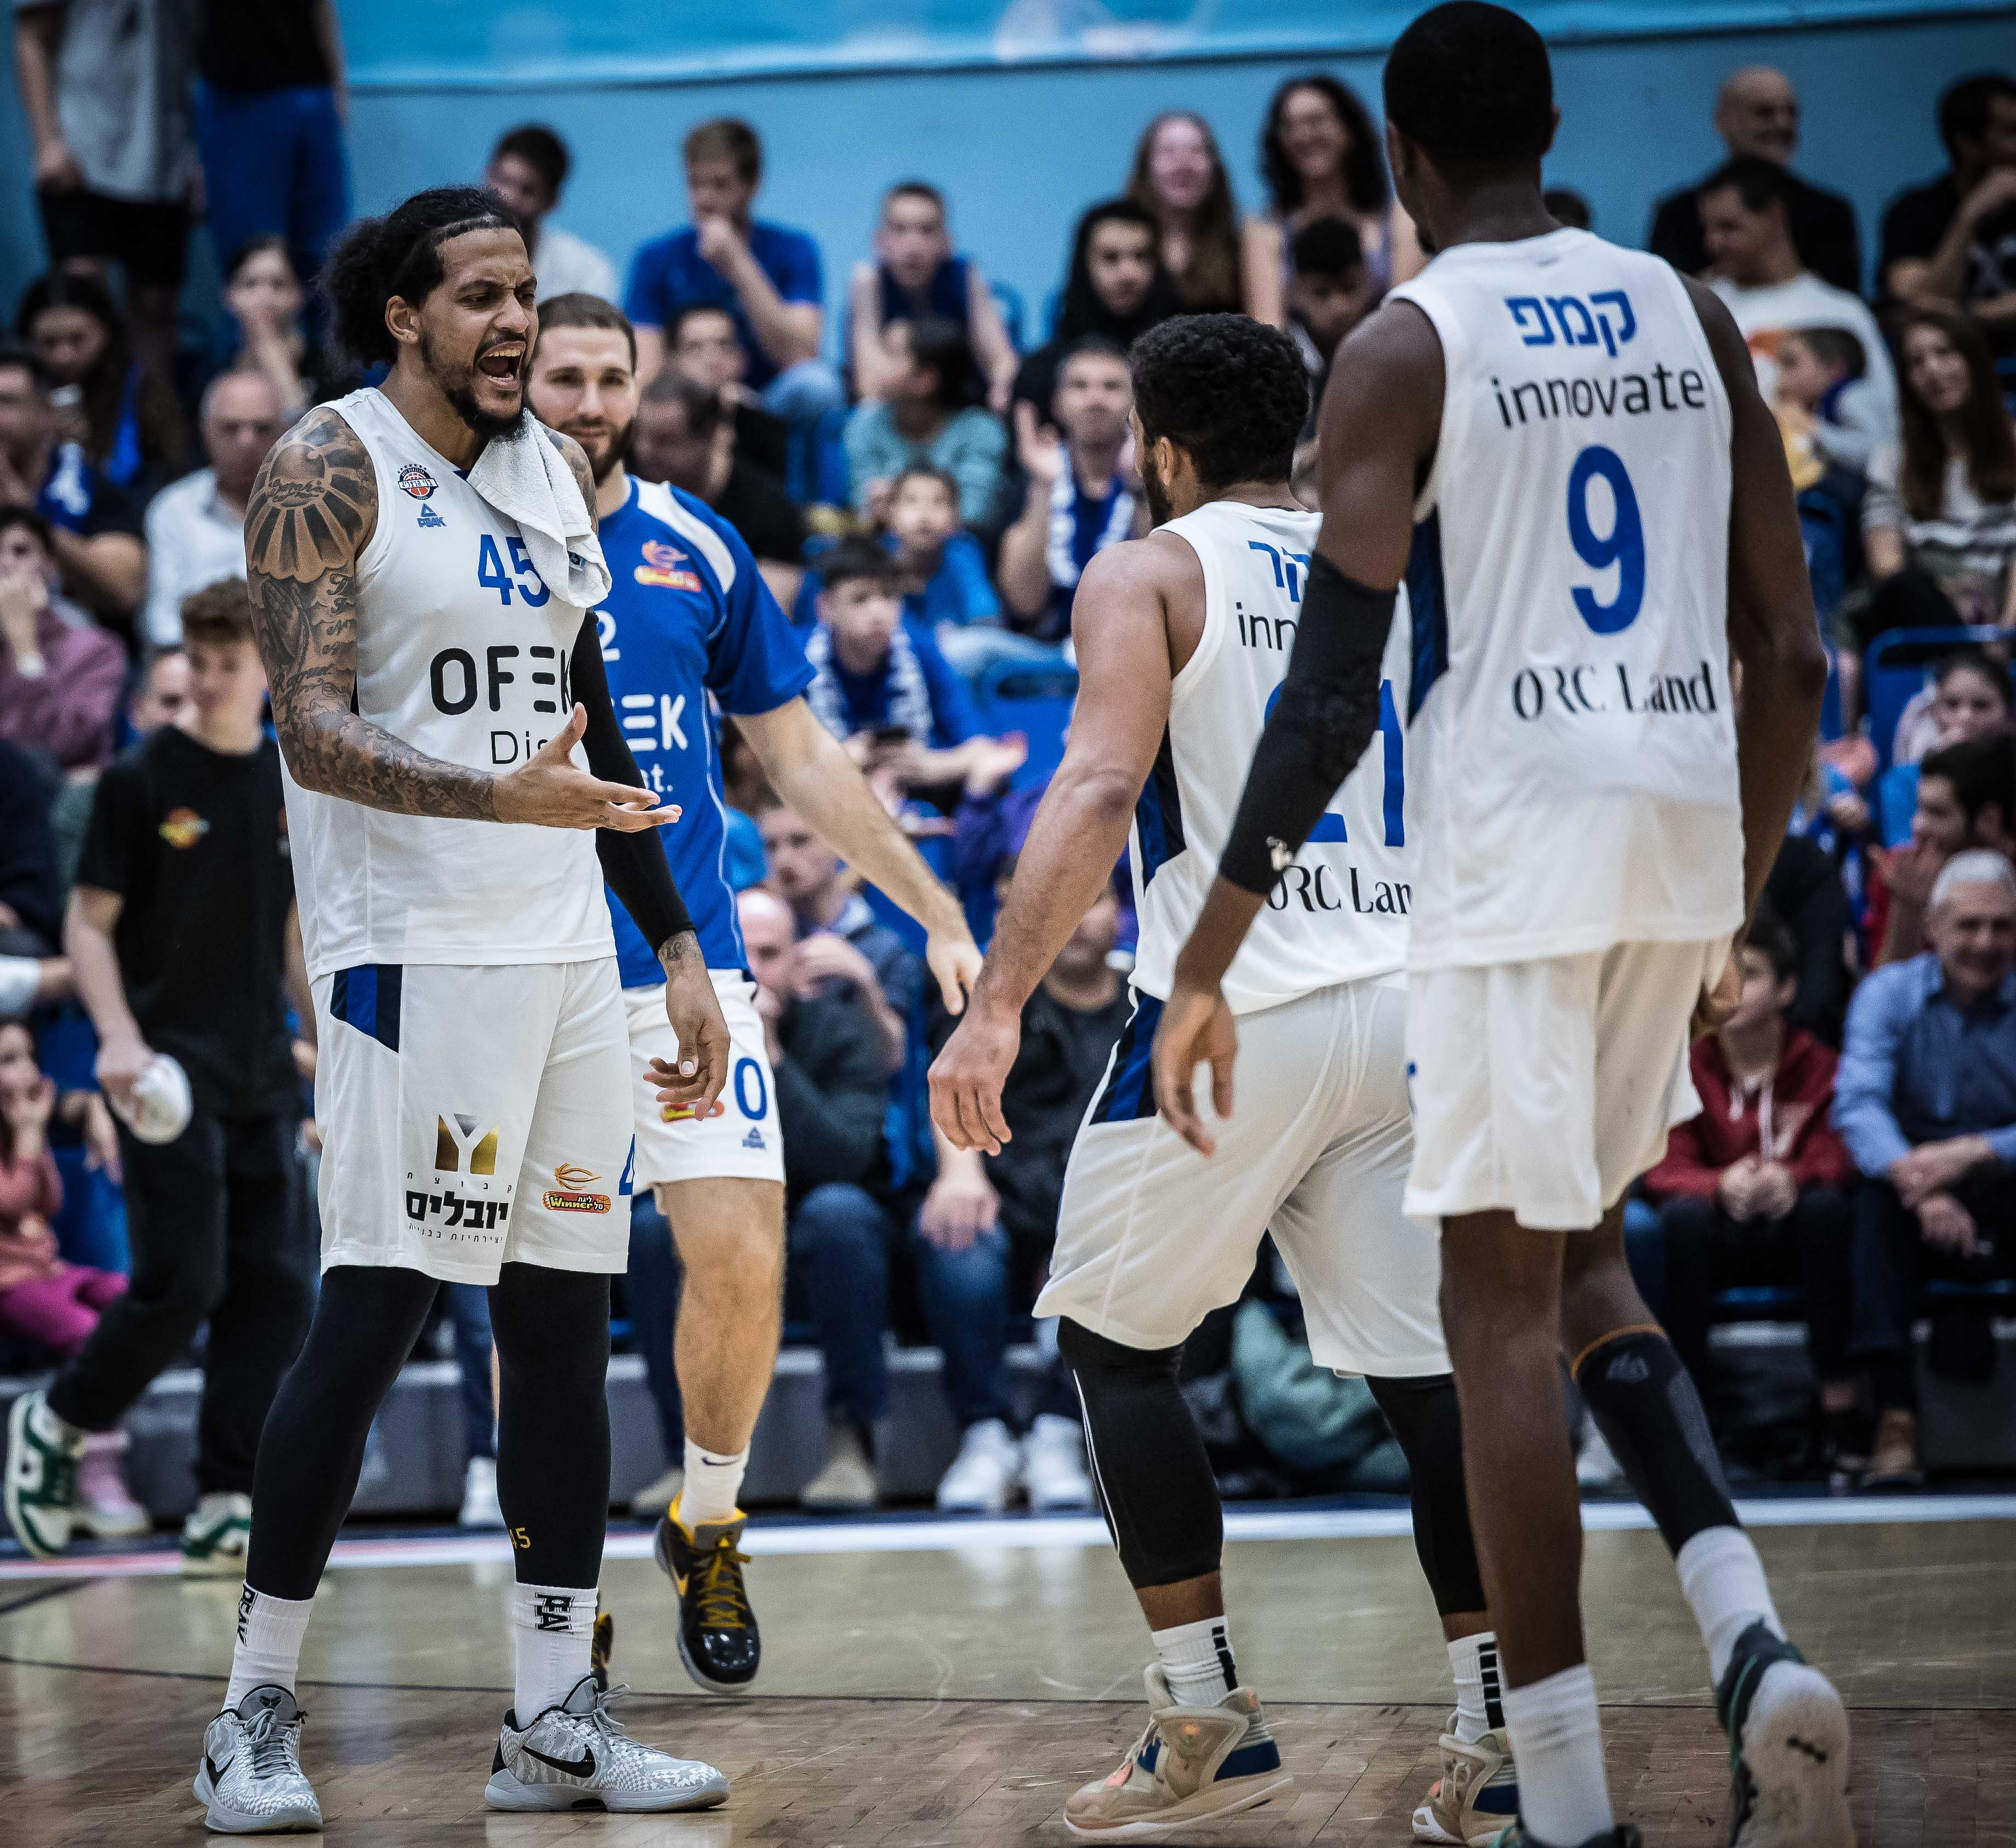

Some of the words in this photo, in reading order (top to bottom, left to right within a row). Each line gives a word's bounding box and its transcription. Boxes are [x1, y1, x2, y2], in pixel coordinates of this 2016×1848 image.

[1504, 290, 1637, 357] קמפ
[1491, 362, 1705, 429] innovate
[478, 534, 550, 607] 45
[1567, 443, 1648, 636] 9
[430, 646, 572, 716] OFEK
[1614, 659, 1717, 714] Land
[1349, 867, 1413, 915] Lan
[406, 1190, 509, 1229] יובלים
